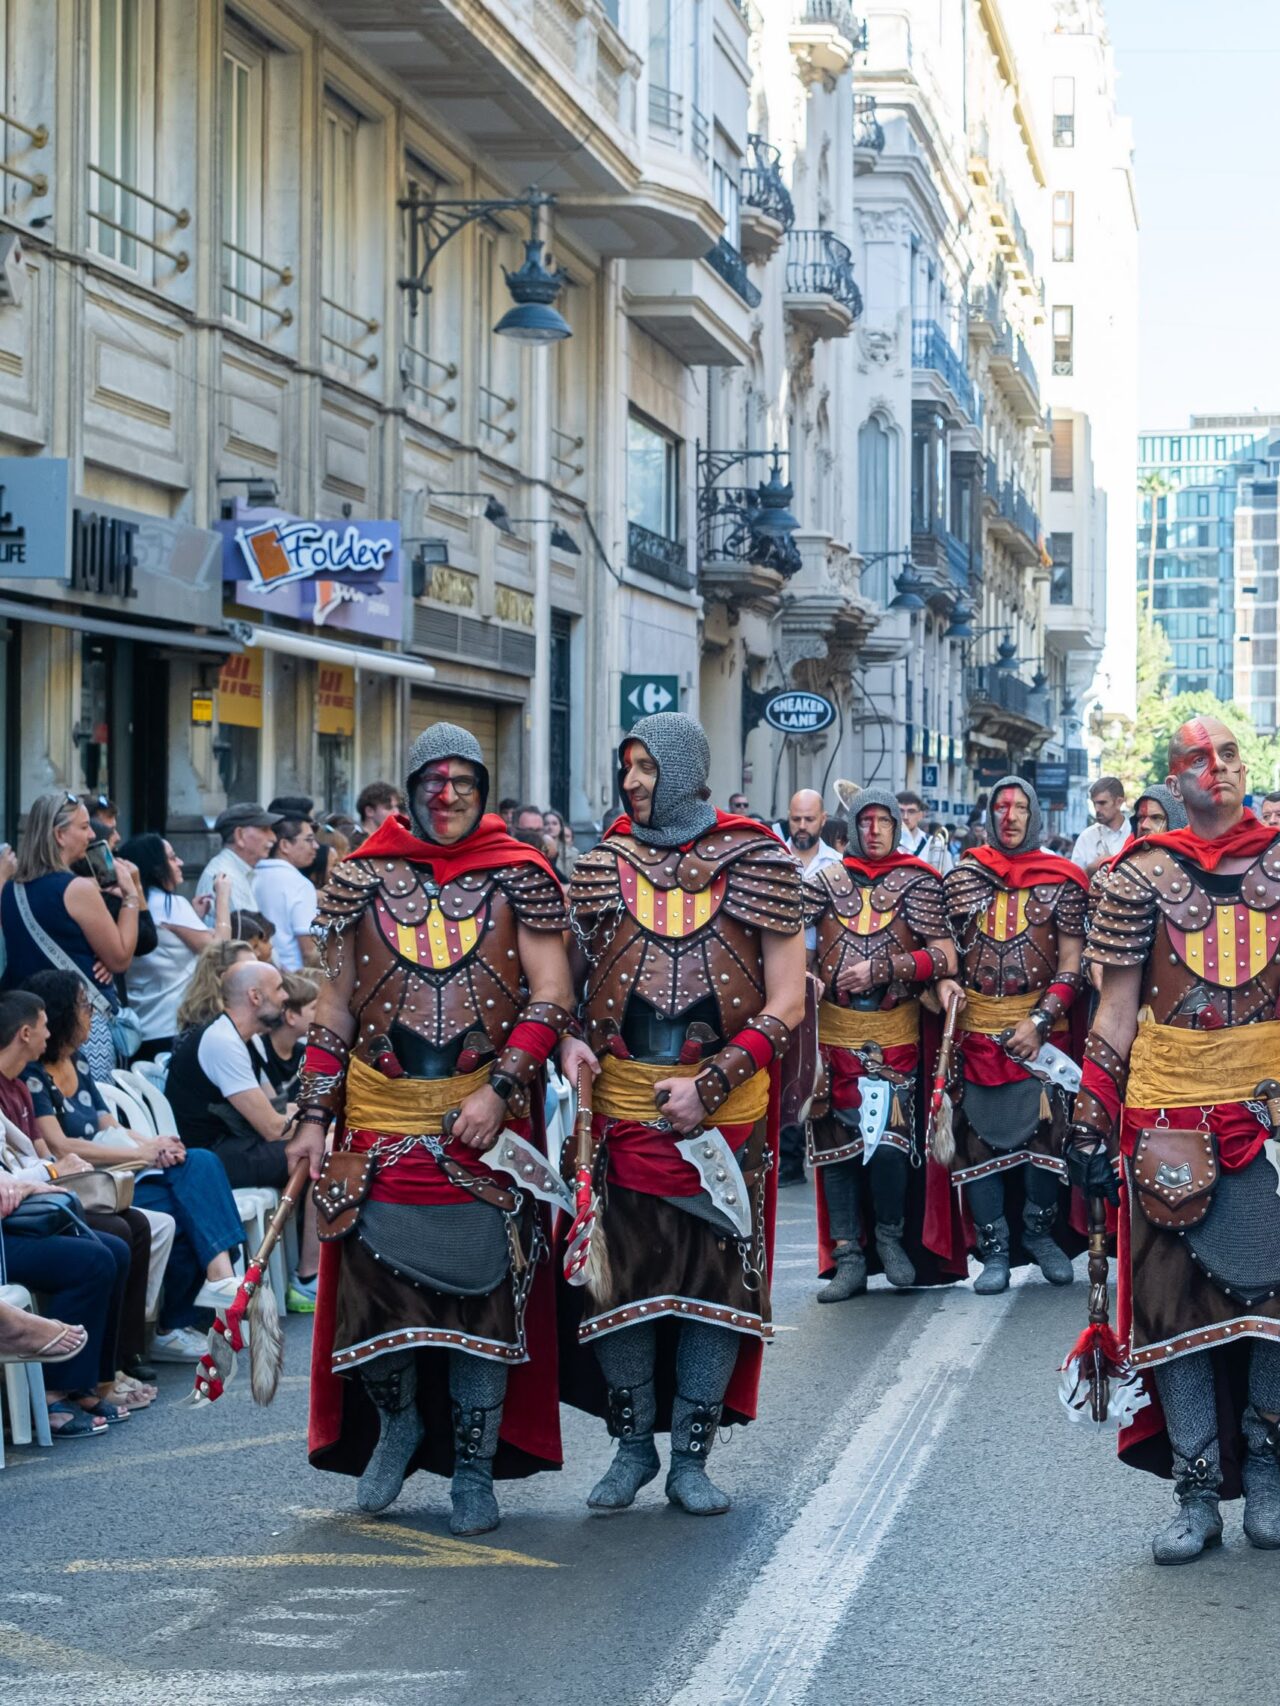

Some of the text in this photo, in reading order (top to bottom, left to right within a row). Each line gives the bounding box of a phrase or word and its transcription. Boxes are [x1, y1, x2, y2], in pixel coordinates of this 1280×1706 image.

[276, 525, 389, 568] Folder
[773, 697, 825, 713] SNEAKER
[780, 713, 818, 727] LANE
